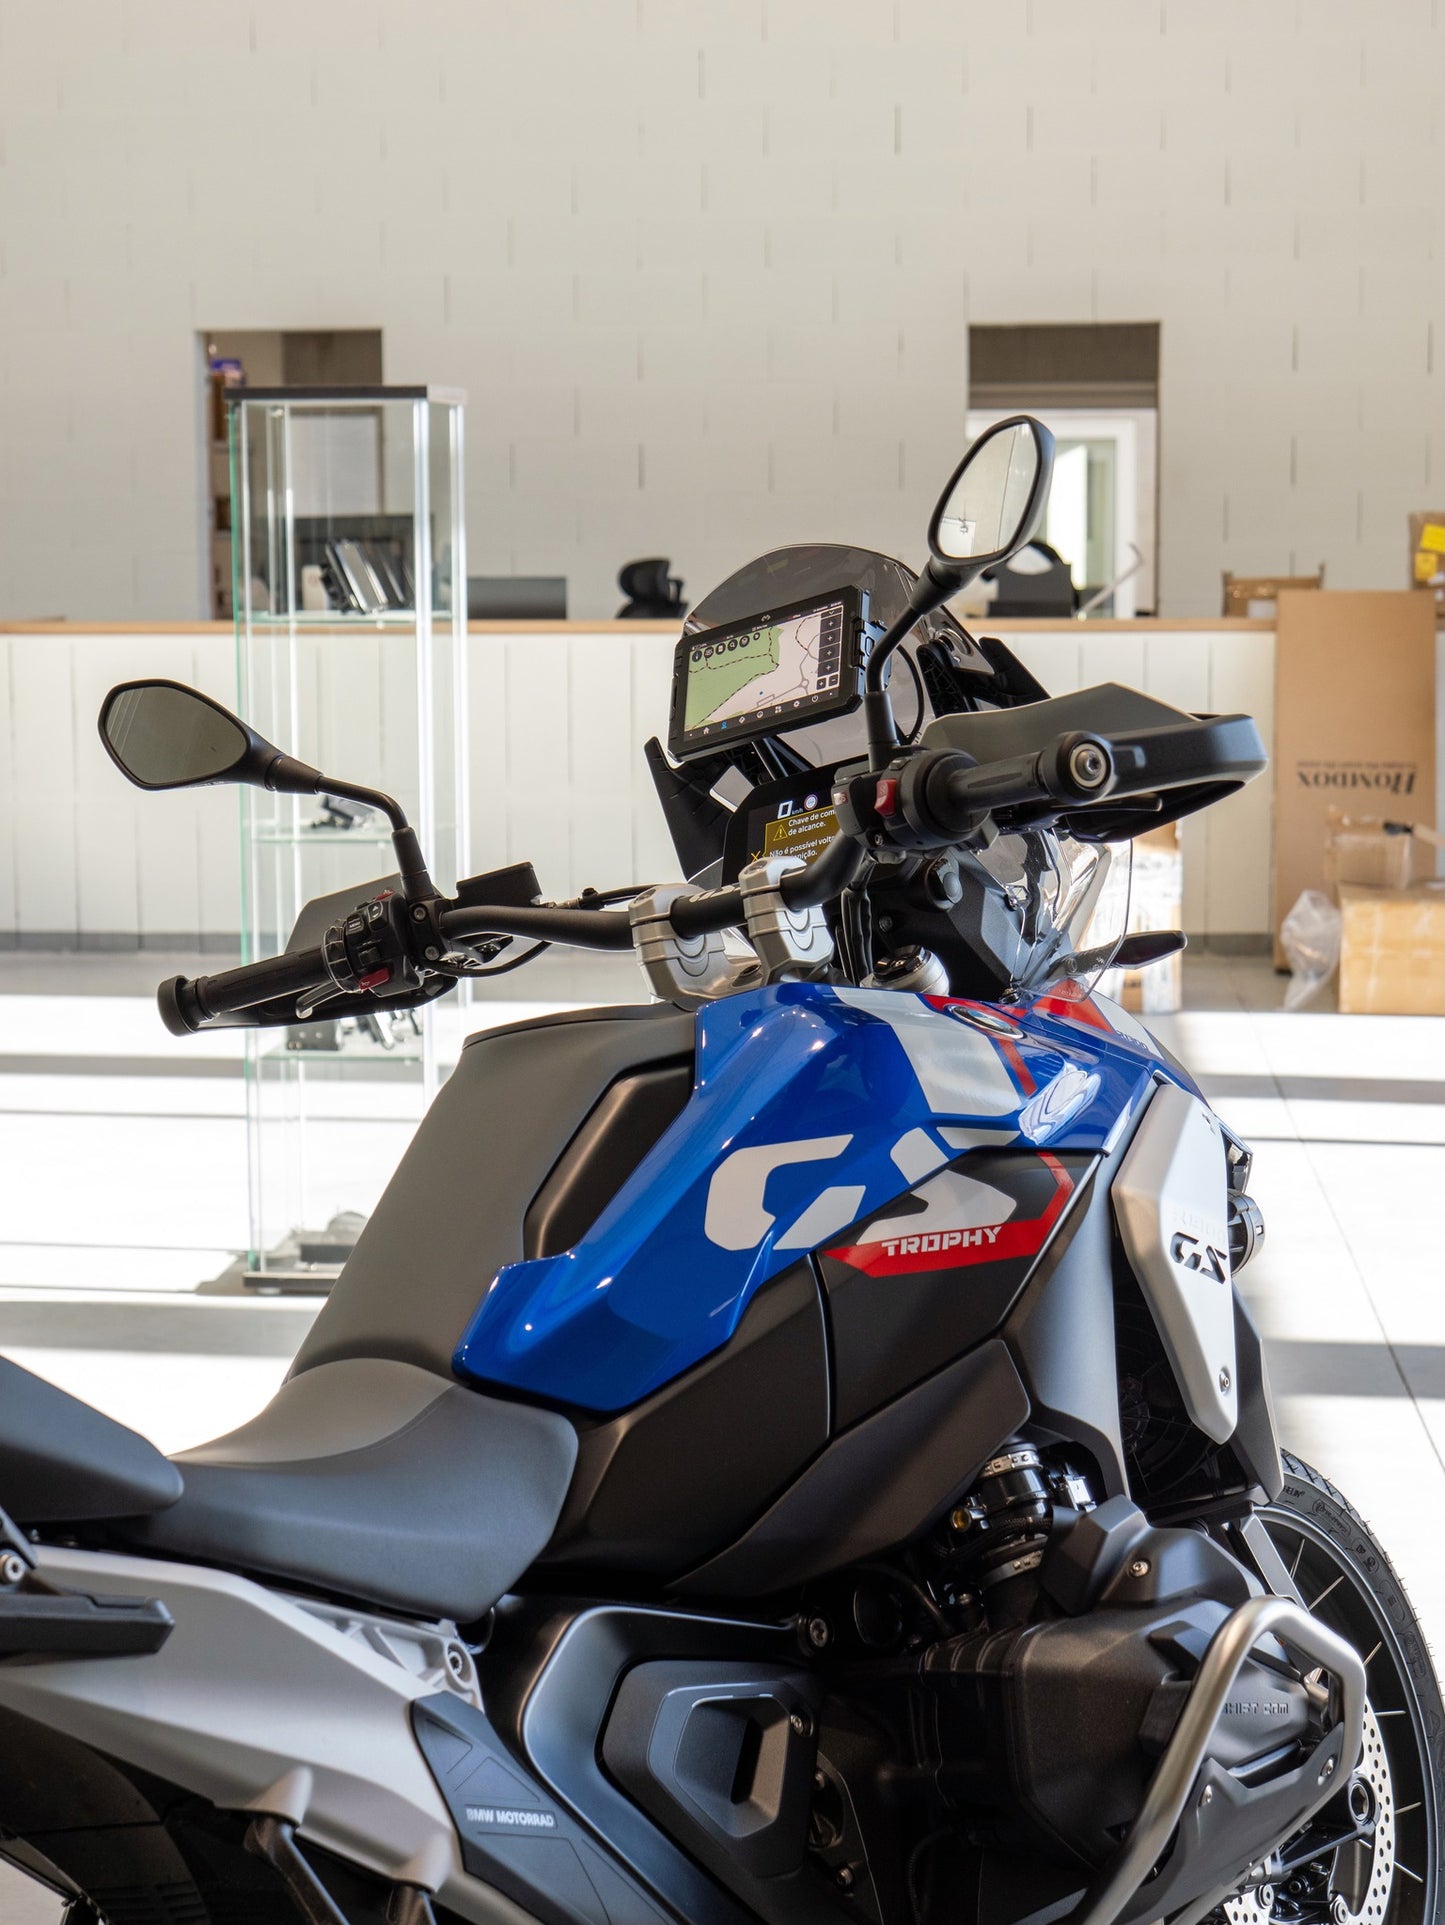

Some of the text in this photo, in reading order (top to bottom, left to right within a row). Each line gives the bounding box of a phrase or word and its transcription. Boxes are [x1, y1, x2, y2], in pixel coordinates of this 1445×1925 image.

[788, 809, 836, 827] Chave de com
[797, 821, 826, 833] alcance.
[769, 849, 783, 858] Não
[784, 846, 789, 854] é
[789, 839, 818, 854] possível
[704, 1126, 1020, 1251] GS
[881, 1226, 1002, 1257] TROPHY
[1169, 1231, 1228, 1285] GS
[466, 1807, 555, 1828] BMW MOTORRAD
